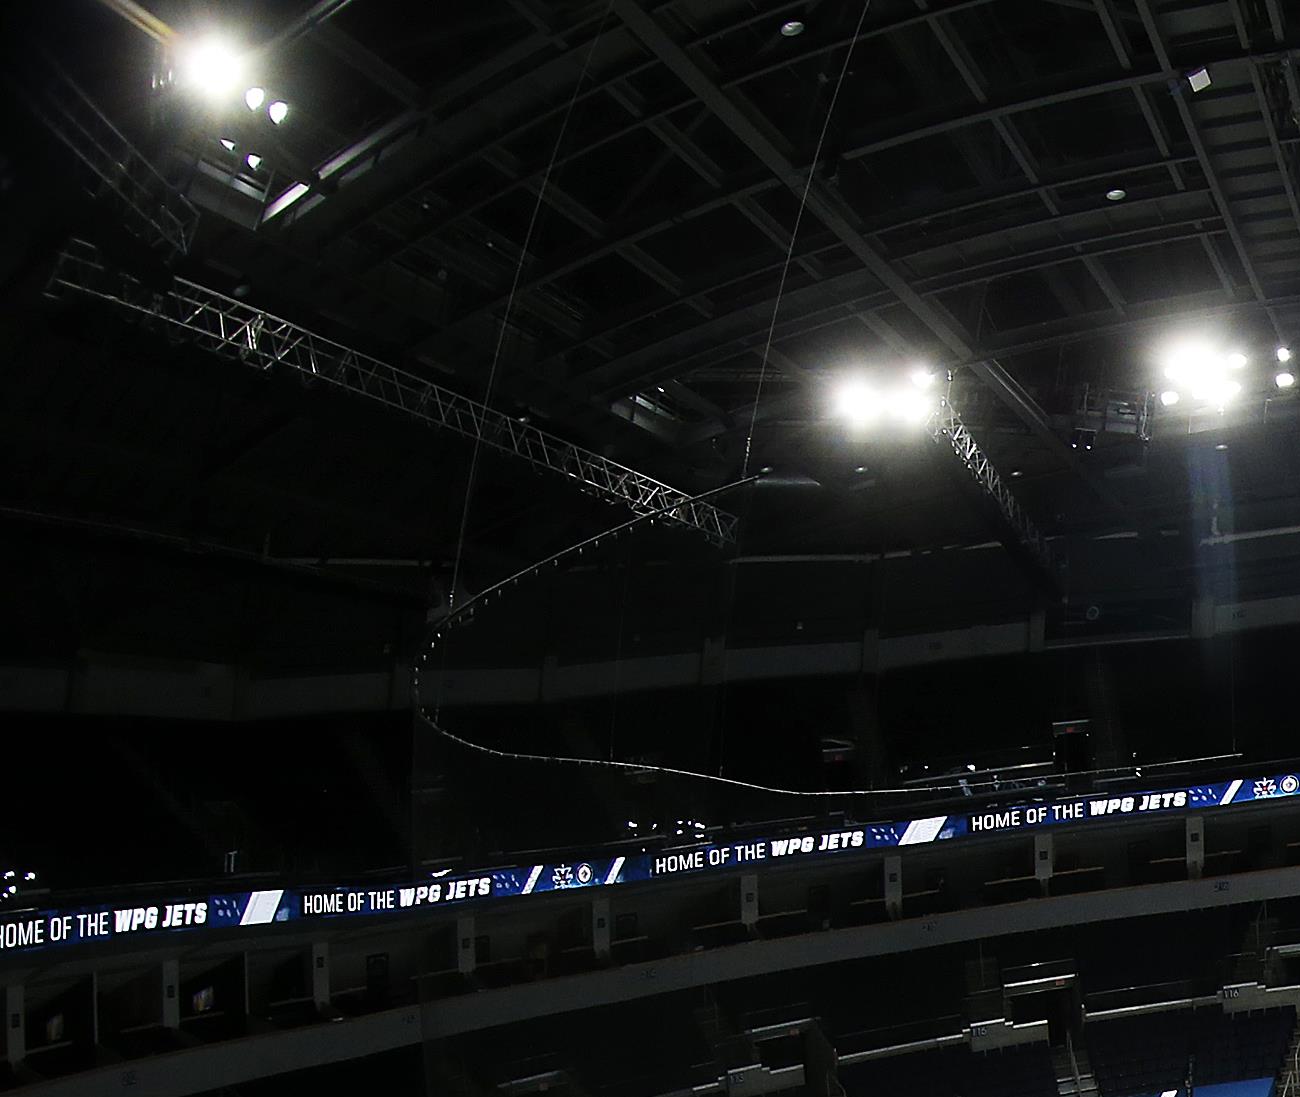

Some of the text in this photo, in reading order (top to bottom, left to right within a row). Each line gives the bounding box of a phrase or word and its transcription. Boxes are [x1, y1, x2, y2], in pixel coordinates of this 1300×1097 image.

[971, 791, 1187, 832] HOME OF THE WPG JETS
[655, 830, 864, 874] HOME OF THE WPG JETS
[303, 877, 491, 914] HOME OF THE WPG JETS
[50, 902, 208, 942] OF THE WPG JETS
[1223, 989, 1239, 998] 116
